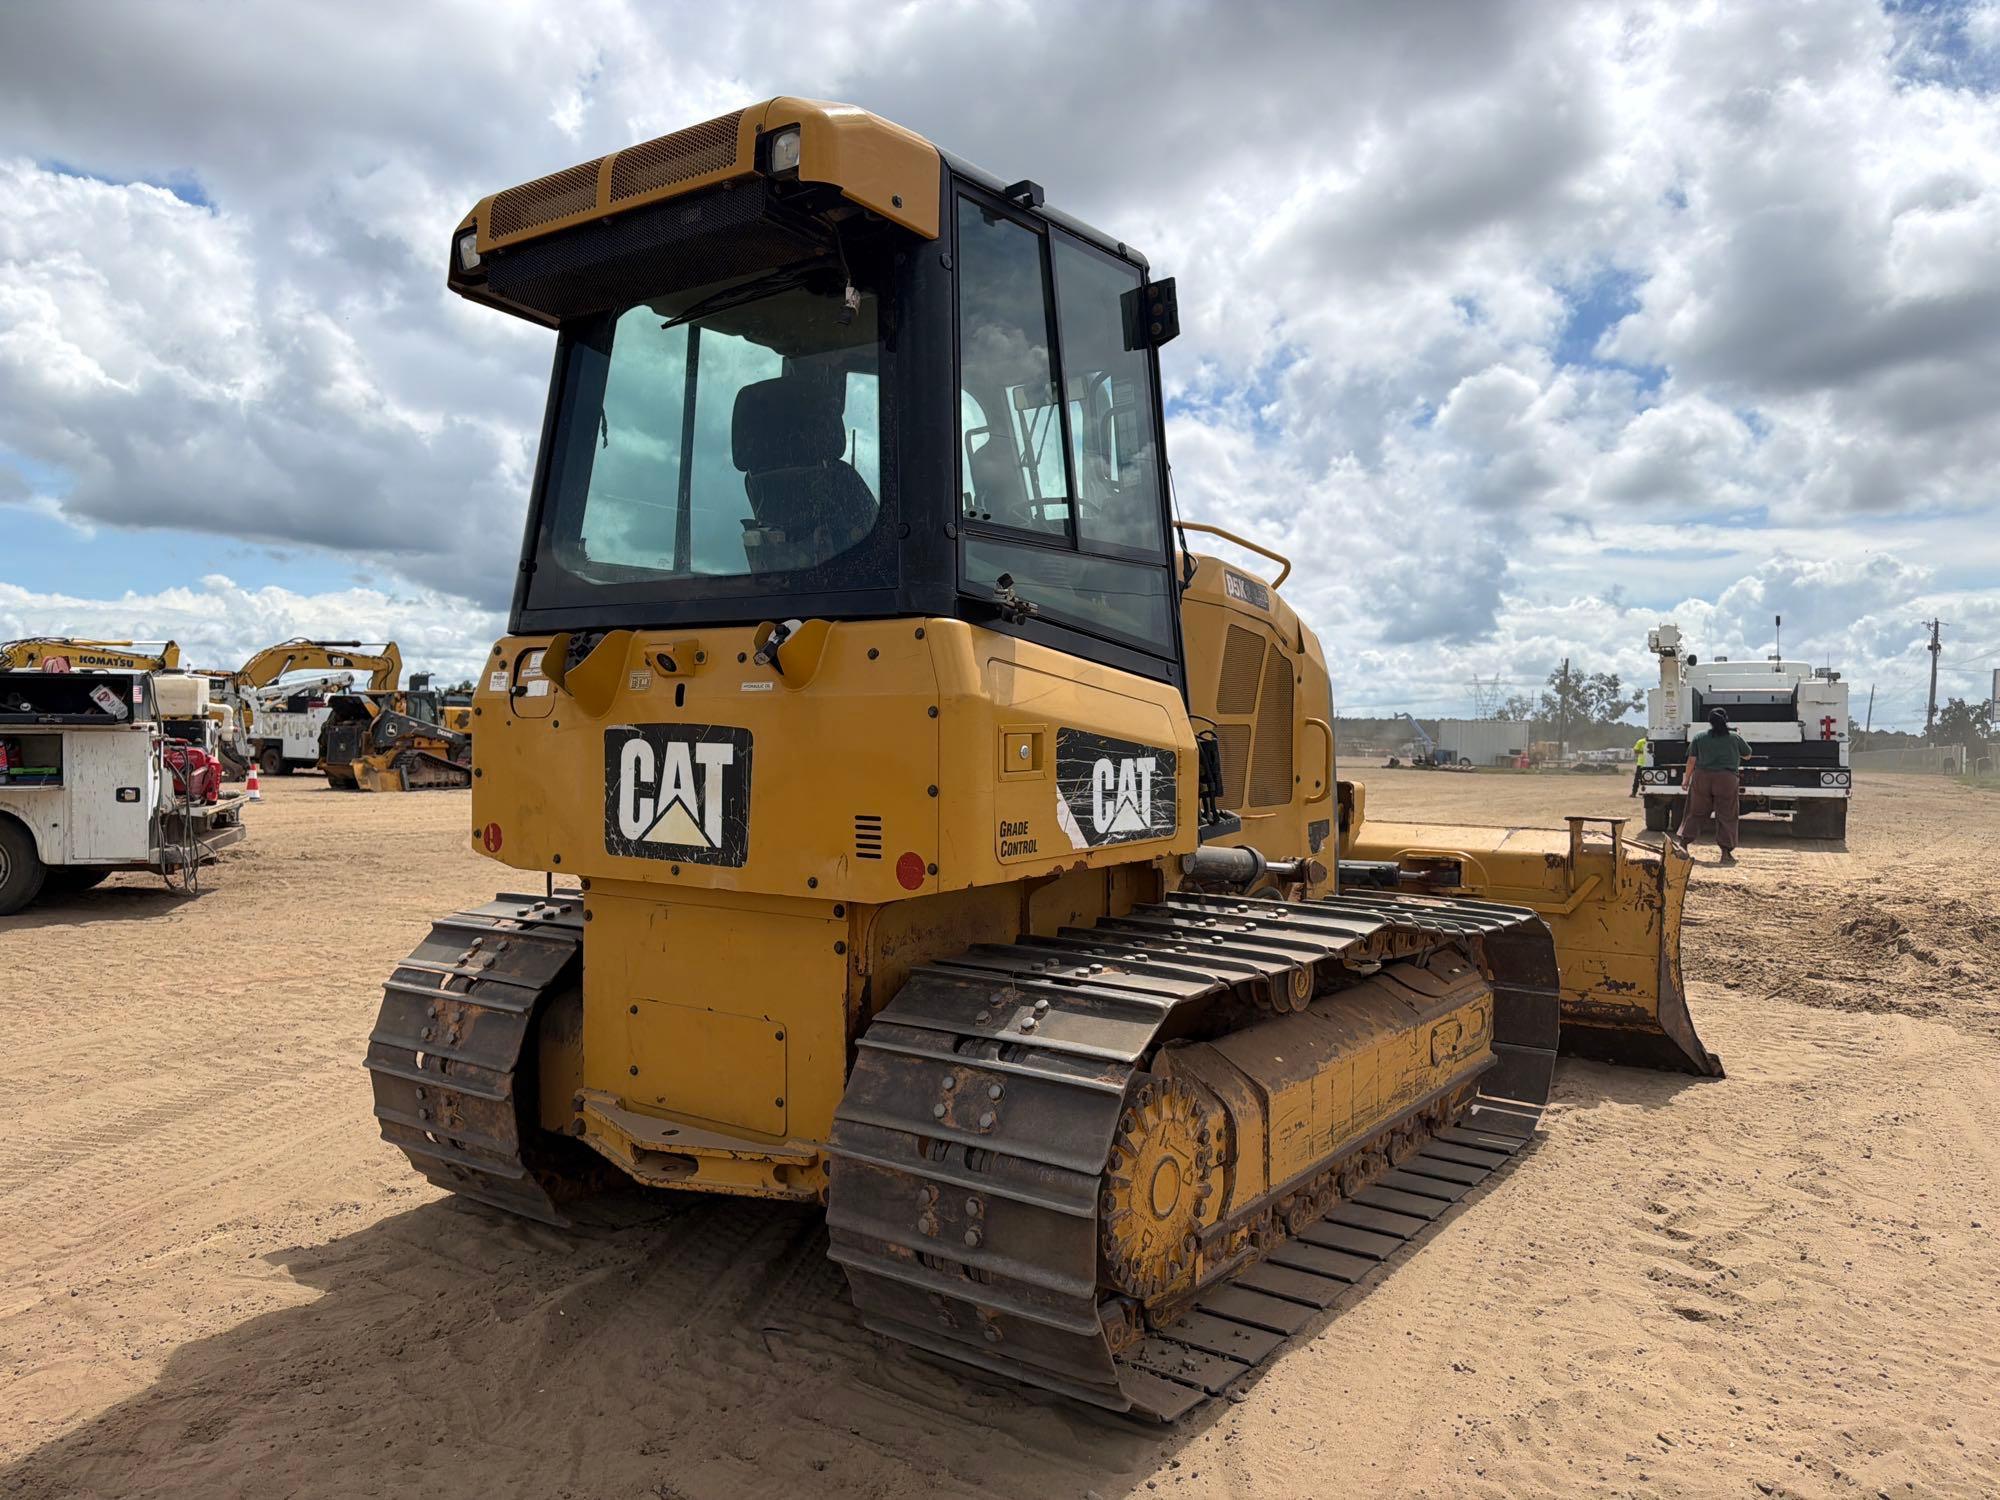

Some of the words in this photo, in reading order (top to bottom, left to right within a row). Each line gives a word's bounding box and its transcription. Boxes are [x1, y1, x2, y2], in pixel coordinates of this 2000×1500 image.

[79, 655, 134, 668] KOMATSU
[332, 656, 345, 667] CAT
[263, 713, 318, 737] Service
[437, 728, 454, 739] DEERE
[619, 738, 734, 849] CAT
[1093, 757, 1156, 834] CAT
